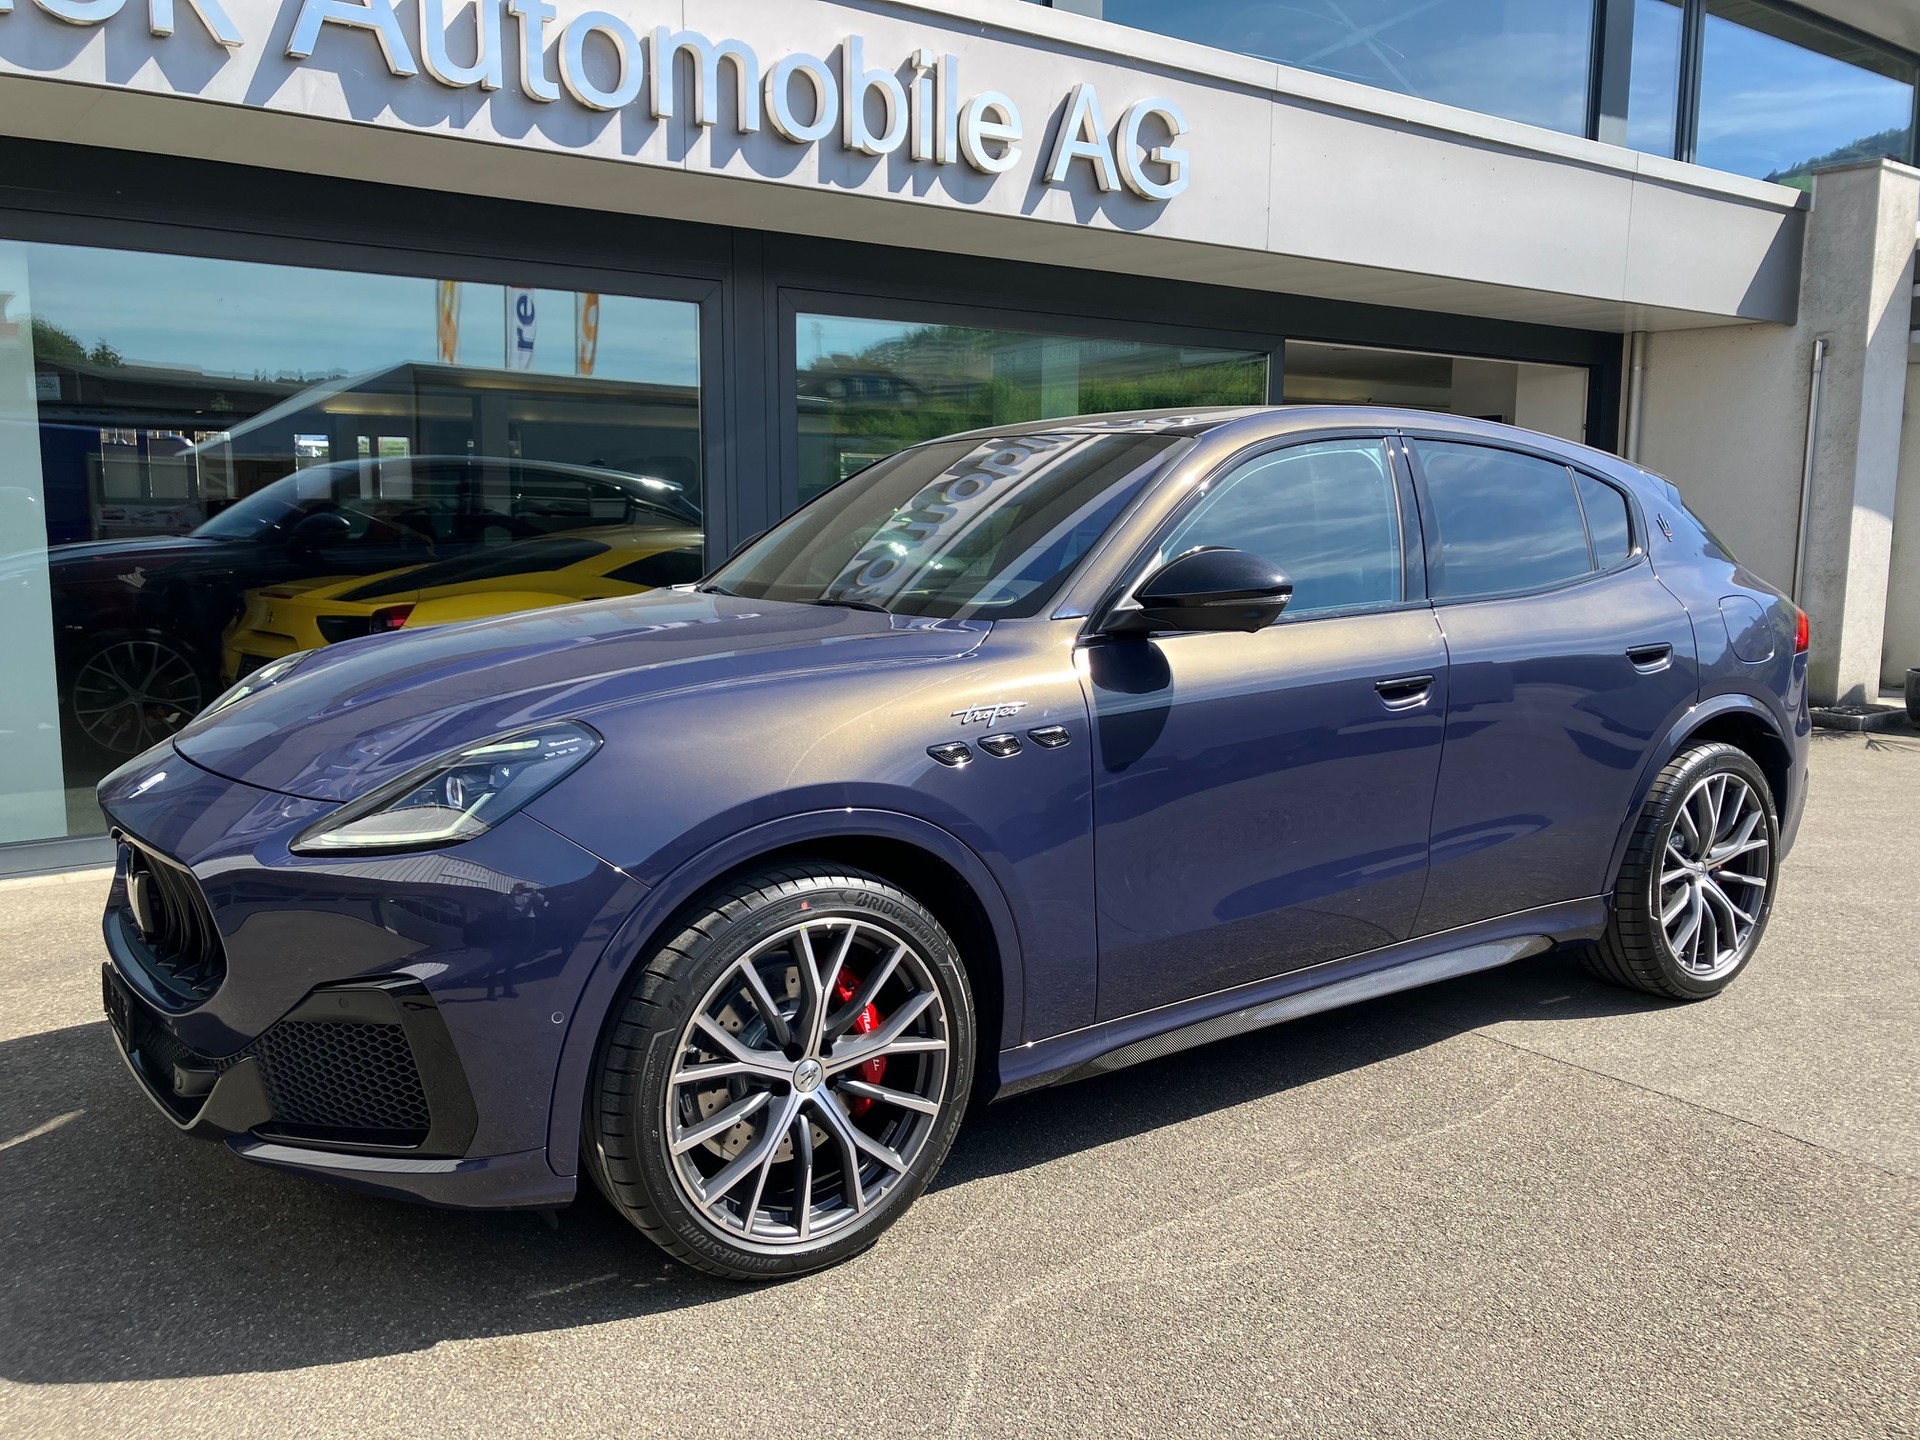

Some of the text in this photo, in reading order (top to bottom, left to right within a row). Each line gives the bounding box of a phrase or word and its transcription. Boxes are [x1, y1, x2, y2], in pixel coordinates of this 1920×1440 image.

[285, 0, 1191, 201] Automobile AG
[950, 702, 1028, 729] trofeo
[855, 891, 945, 957] BRIDGESTONE
